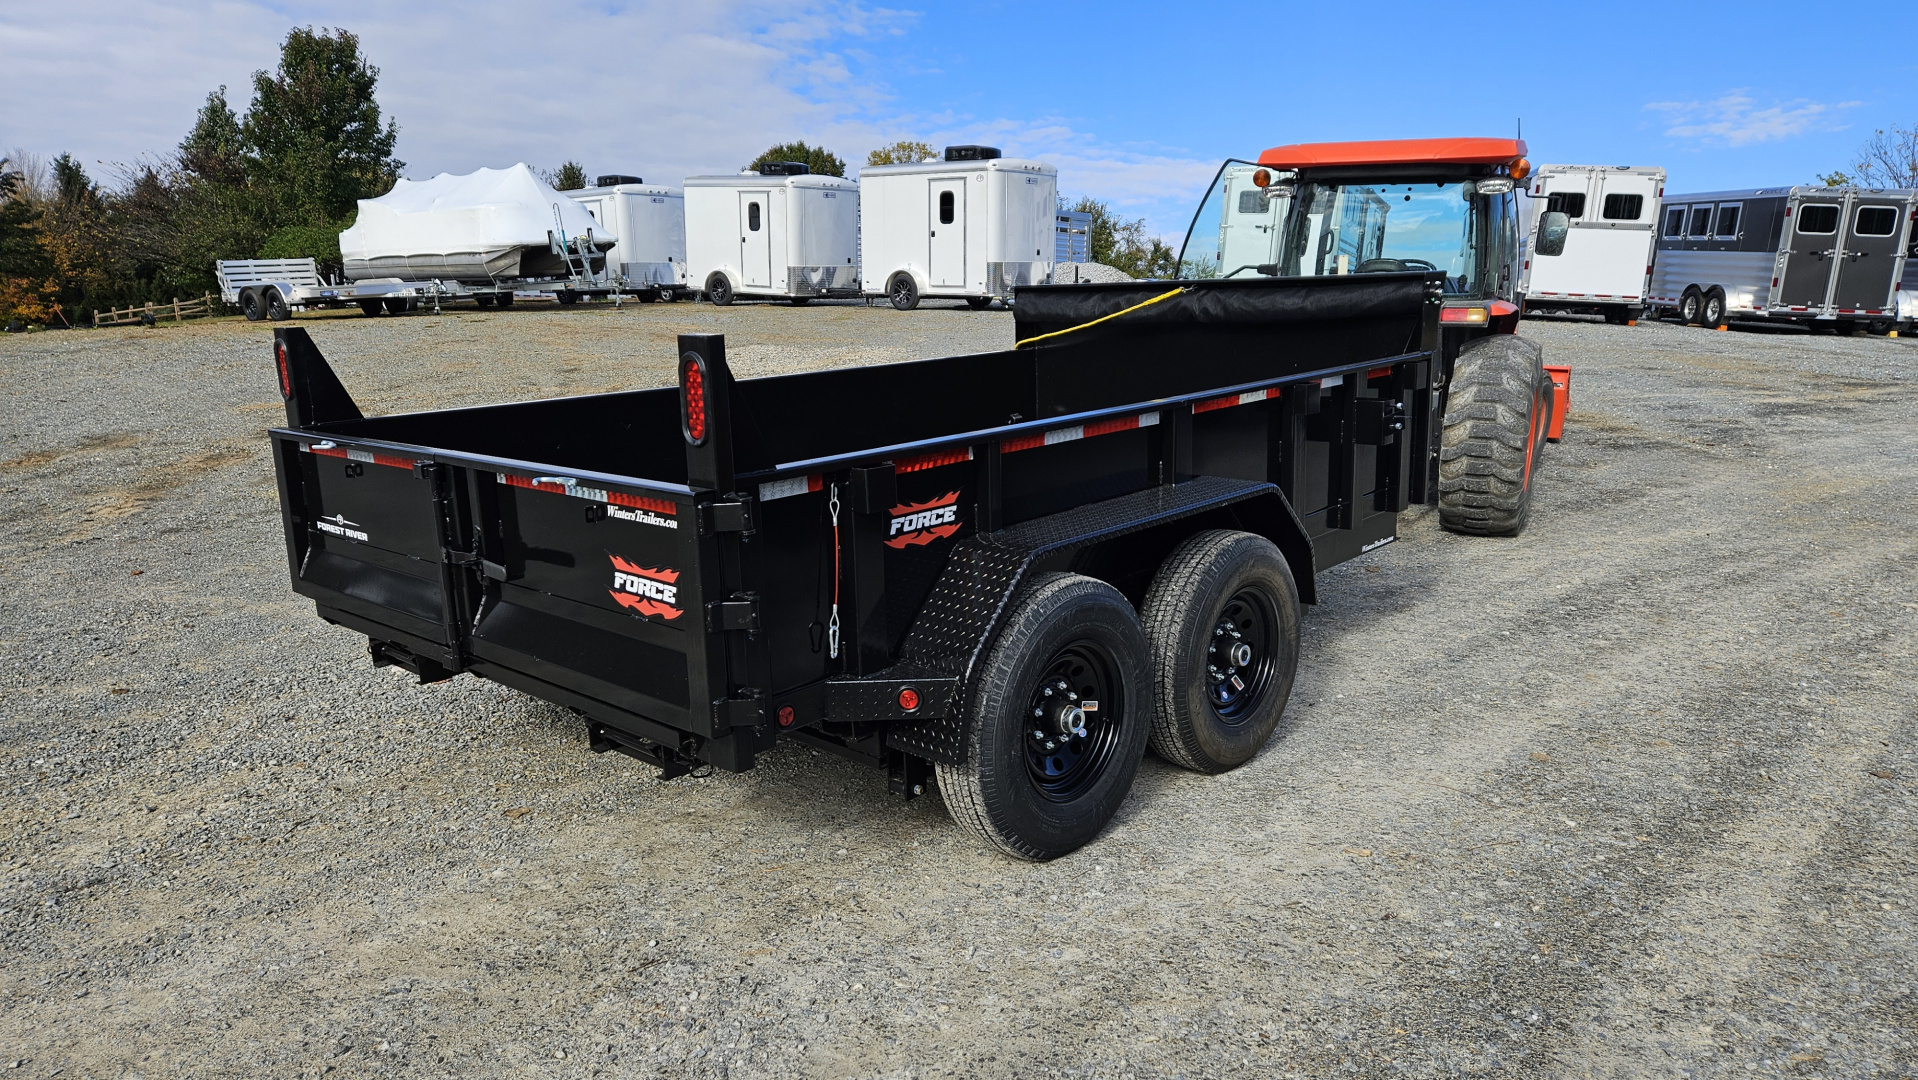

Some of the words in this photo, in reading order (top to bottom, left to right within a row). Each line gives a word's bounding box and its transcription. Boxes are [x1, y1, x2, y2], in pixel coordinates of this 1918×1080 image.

[317, 520, 345, 535] FOREST
[345, 528, 368, 541] RIVER
[890, 505, 957, 535] FORCE
[614, 571, 677, 604] FORCE
